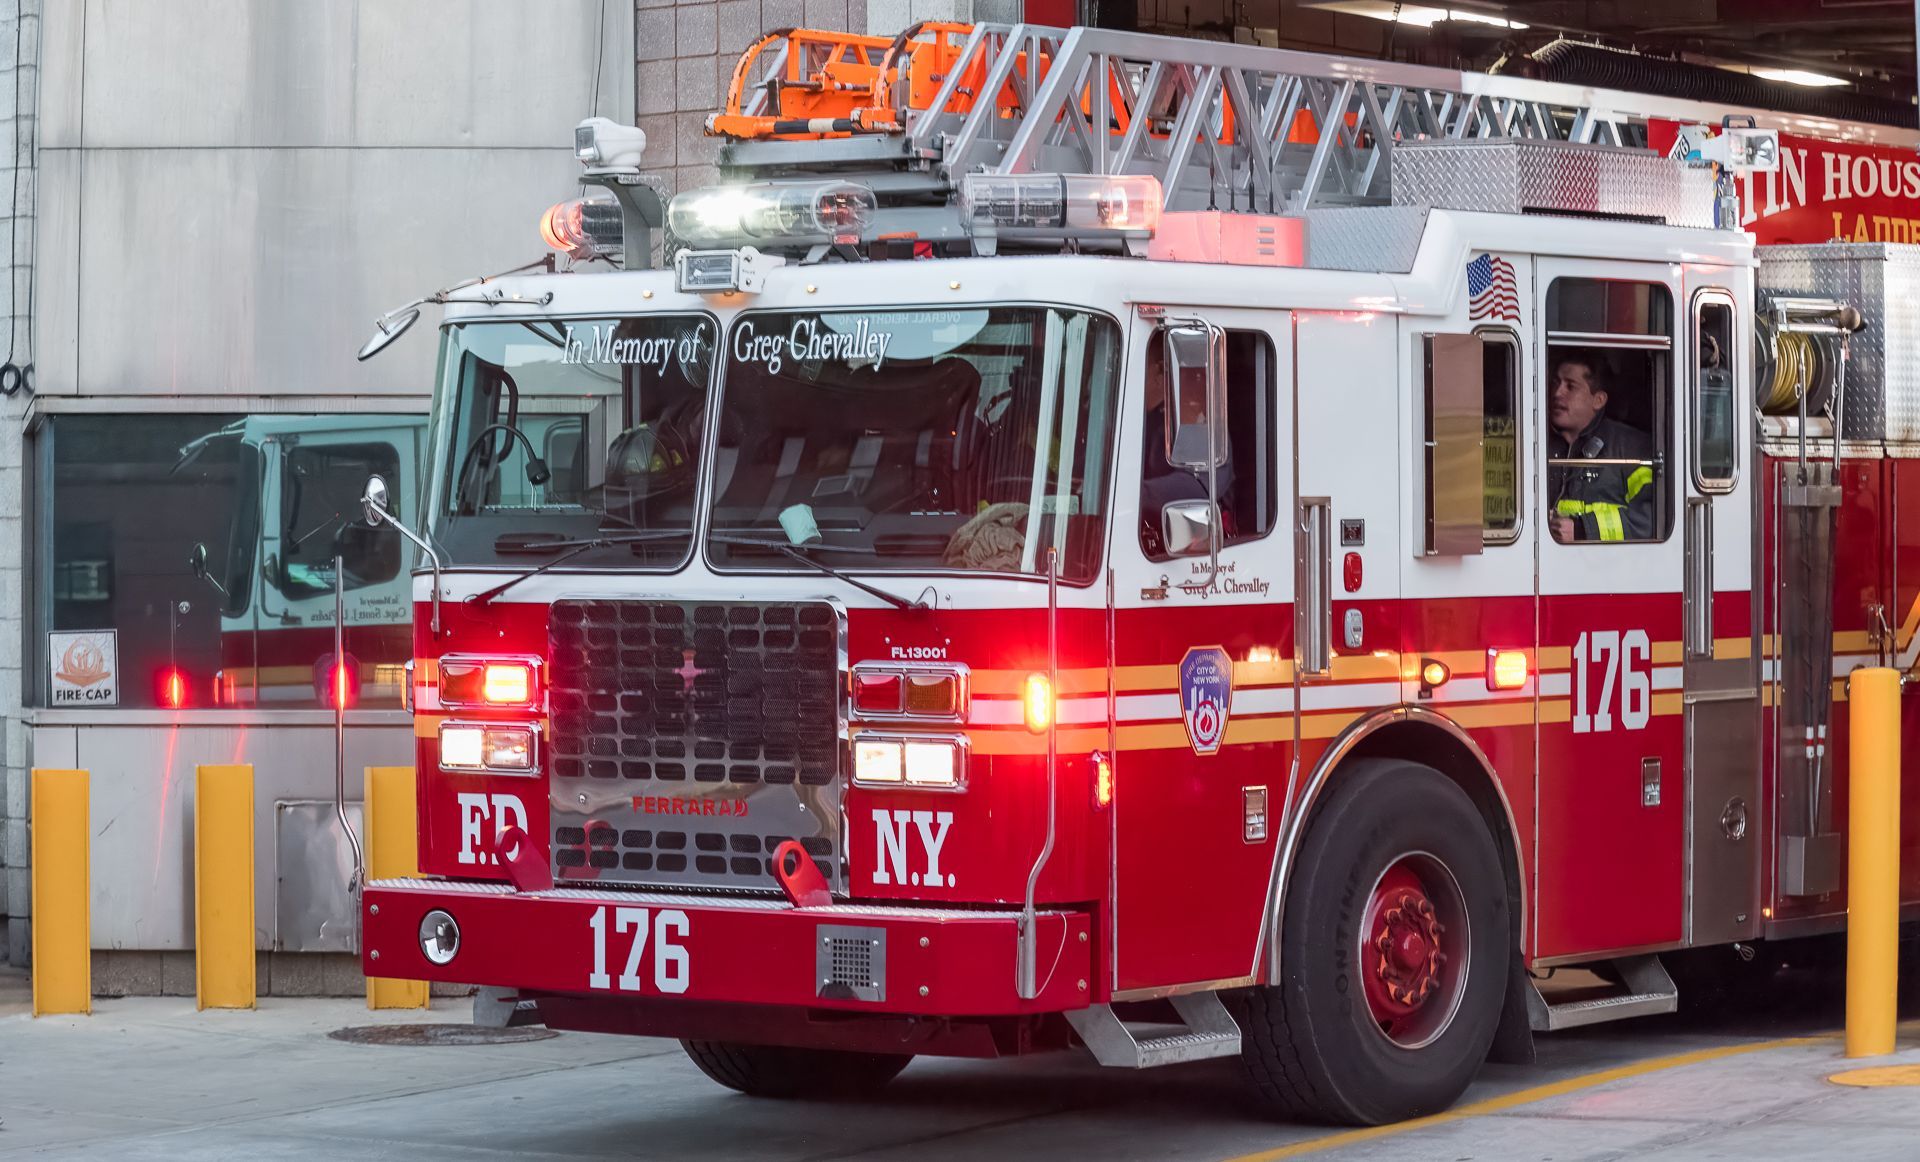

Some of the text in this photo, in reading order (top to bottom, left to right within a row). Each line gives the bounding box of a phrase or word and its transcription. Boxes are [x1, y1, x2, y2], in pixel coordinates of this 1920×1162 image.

[560, 323, 706, 378] In Memory of
[734, 317, 892, 375] Greg Chevalley
[1191, 561, 1236, 576] In Meory of
[1209, 578, 1222, 595] A.
[1223, 578, 1270, 597] Chevalley
[891, 646, 947, 659] FL13001
[1192, 675, 1220, 685] NEW YORK
[1196, 665, 1217, 676] CITY OF
[1572, 629, 1650, 734] 176
[631, 796, 732, 816] FERRARA
[871, 808, 957, 889] N.Y.
[589, 905, 691, 995] 176
